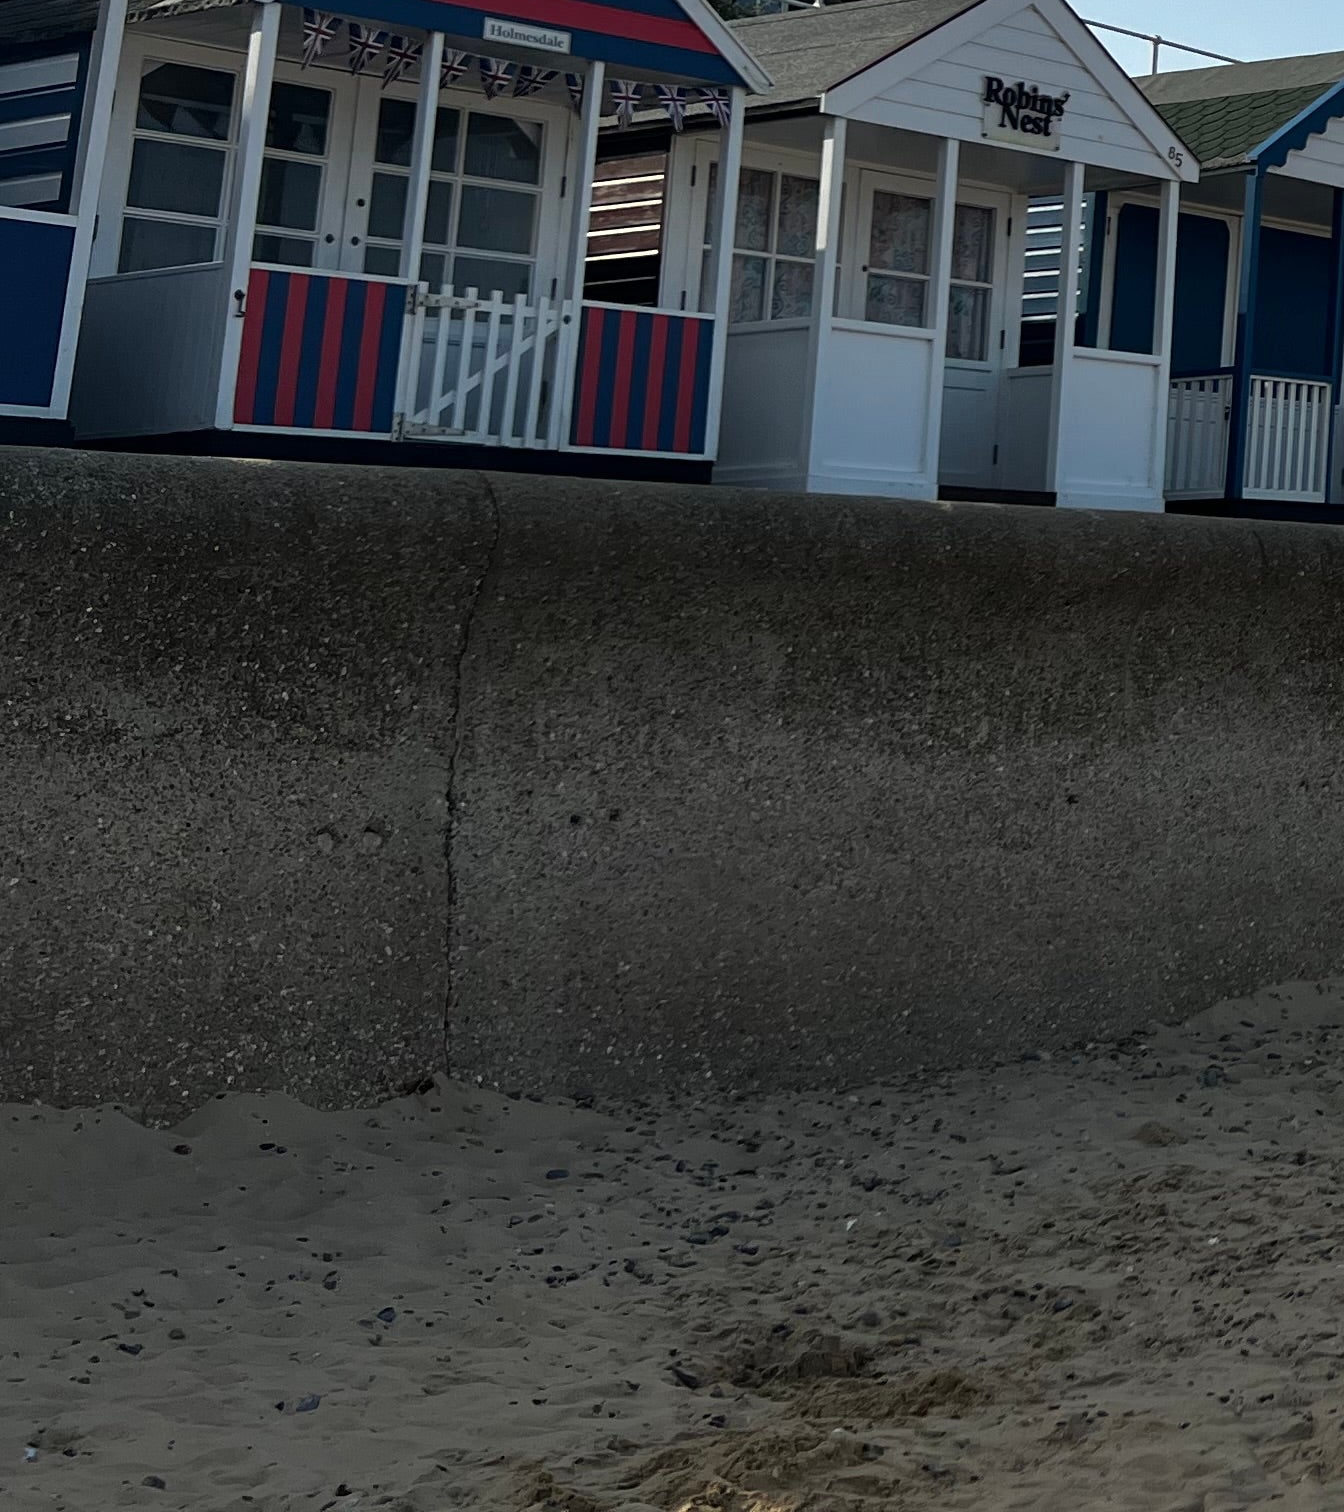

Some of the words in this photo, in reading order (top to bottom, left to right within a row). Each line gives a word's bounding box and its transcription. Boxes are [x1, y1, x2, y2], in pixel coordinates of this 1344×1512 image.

[490, 24, 564, 48] Holmesdale
[998, 107, 1052, 136] Nest
[1168, 146, 1184, 167] 85
